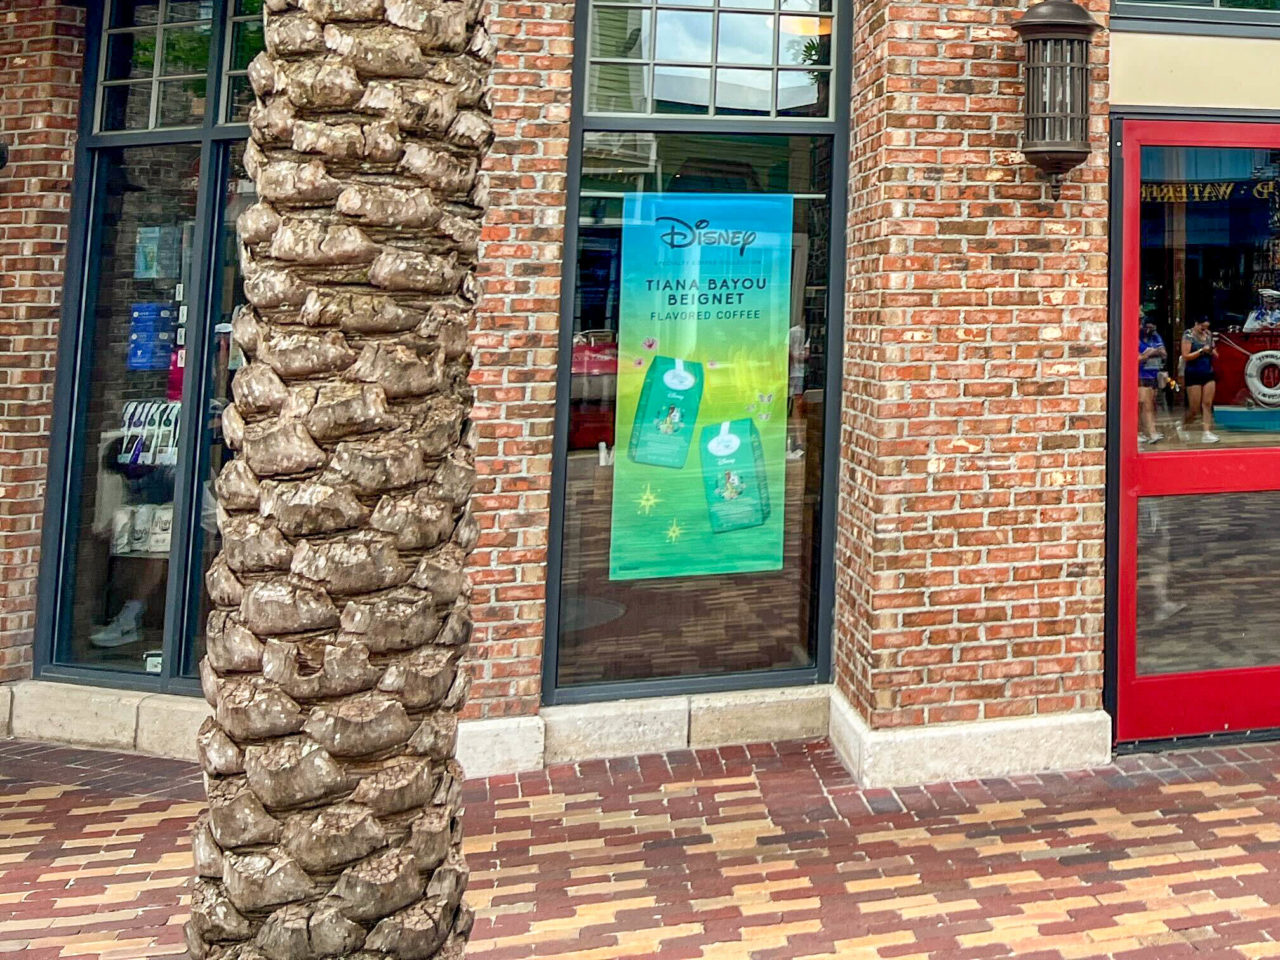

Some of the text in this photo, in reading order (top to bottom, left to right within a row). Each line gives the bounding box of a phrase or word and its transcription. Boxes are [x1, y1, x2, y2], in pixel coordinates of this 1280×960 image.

[646, 278, 767, 291] TIANA BAYOU
[668, 293, 745, 306] BEIGNET
[650, 310, 760, 321] FLAVORED COFFEE
